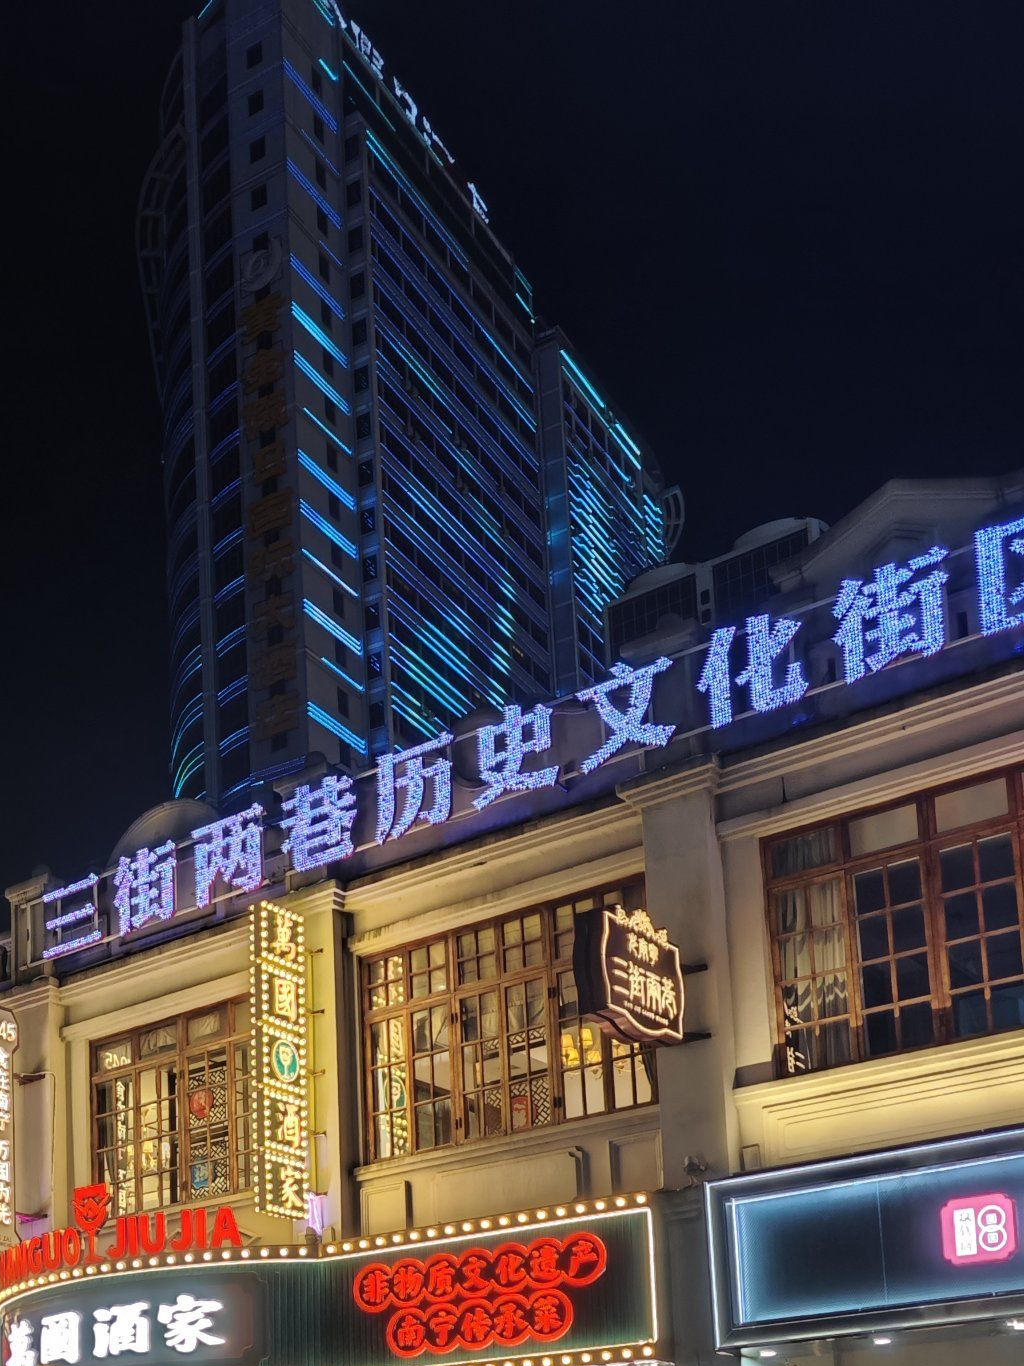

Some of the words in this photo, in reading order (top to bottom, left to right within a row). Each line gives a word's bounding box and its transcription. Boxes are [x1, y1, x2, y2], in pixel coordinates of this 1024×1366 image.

[364, 1239, 598, 1304] 非物质文化遗产
[397, 1295, 564, 1347] 南宁传承菜
